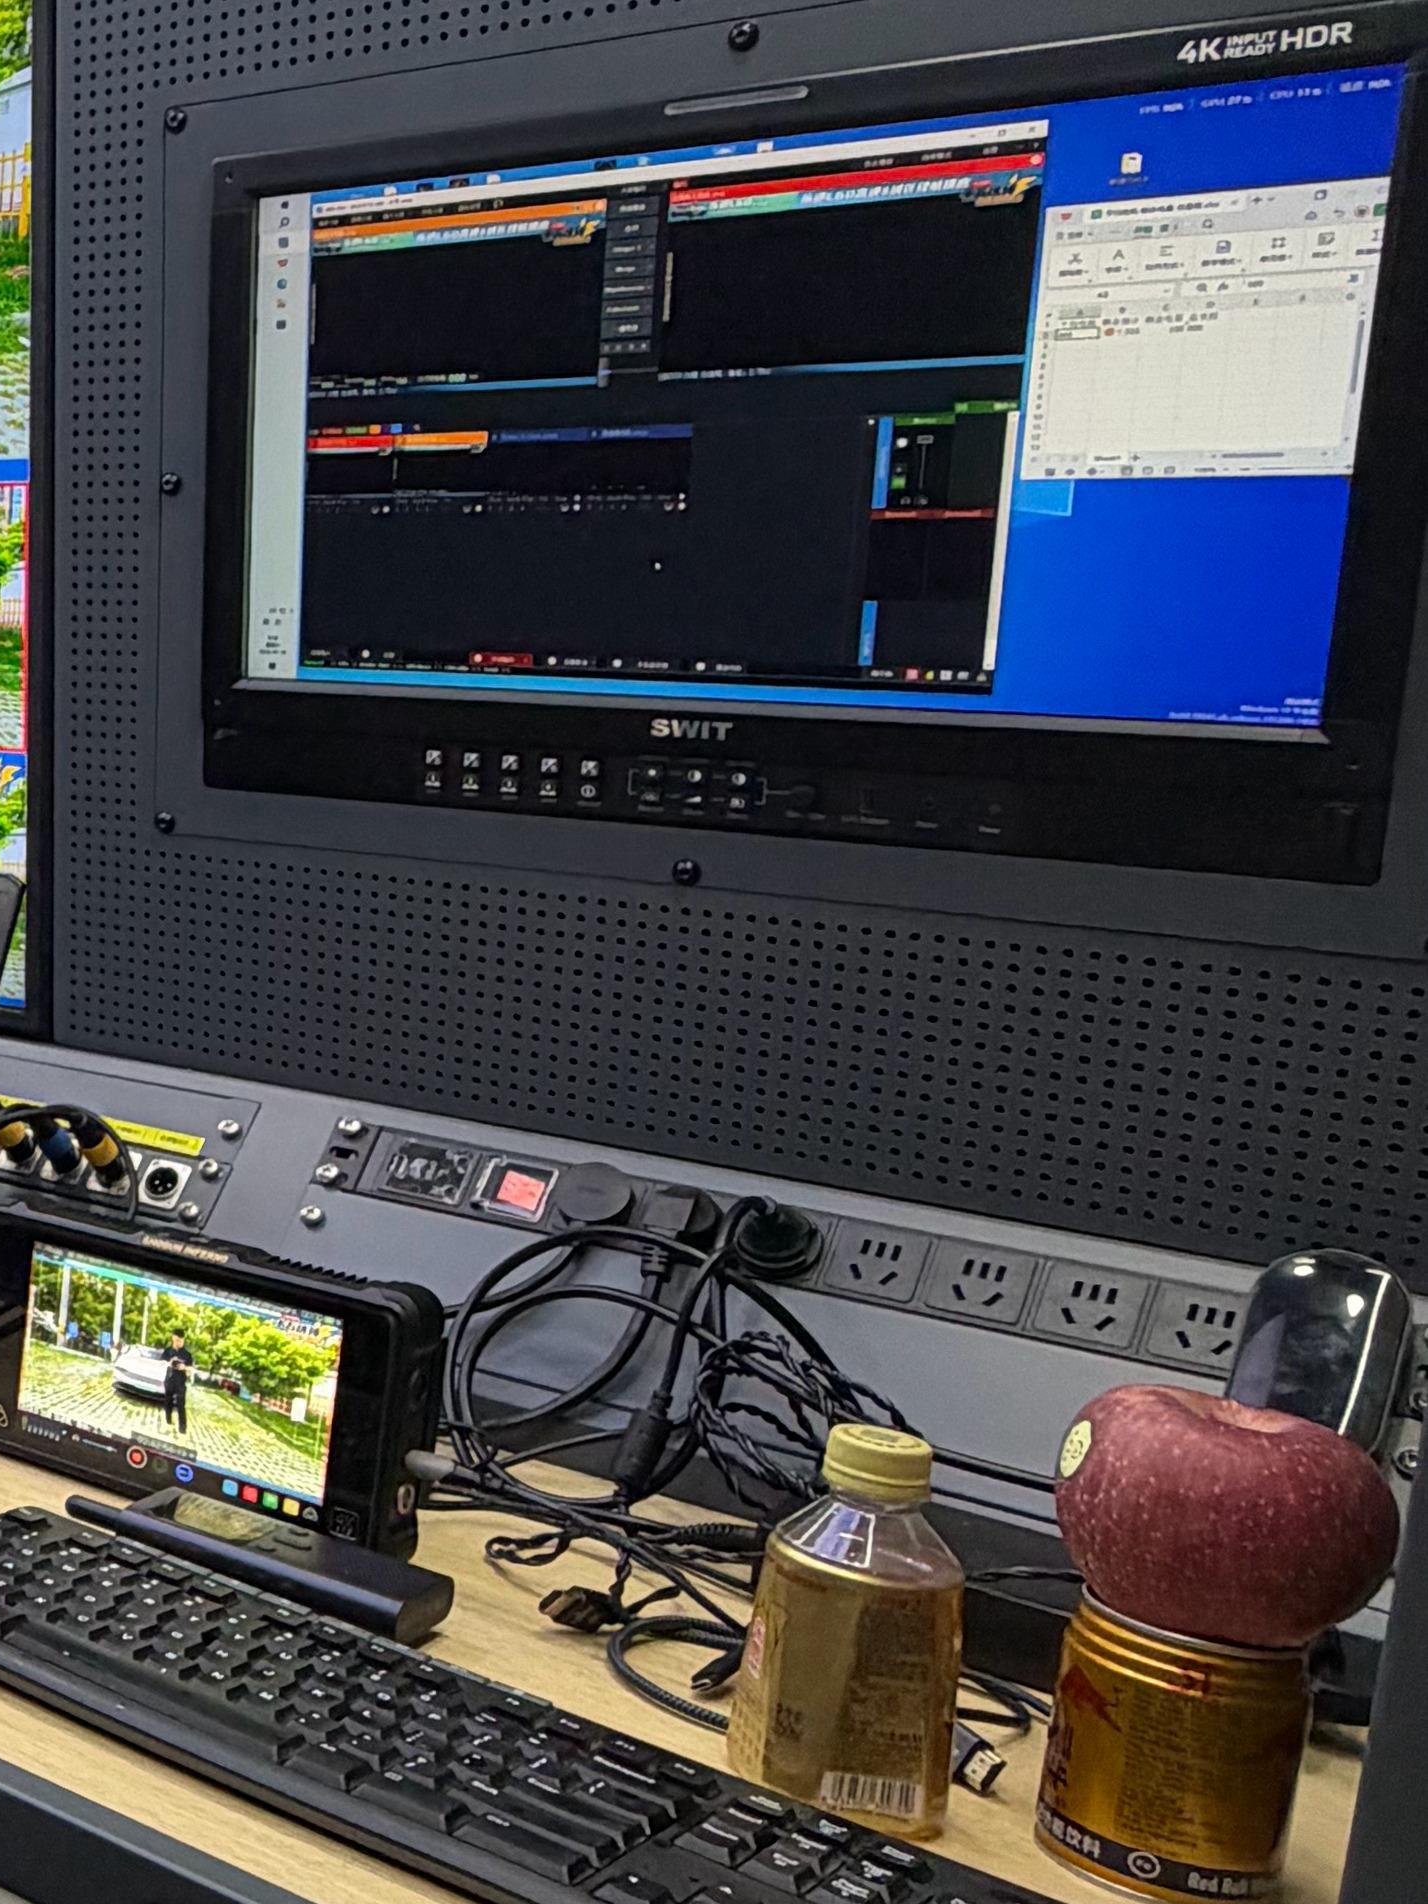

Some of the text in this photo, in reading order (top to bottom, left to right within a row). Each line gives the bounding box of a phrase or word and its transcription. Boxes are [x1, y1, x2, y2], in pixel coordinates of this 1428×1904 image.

[1177, 21, 1354, 64] 4K INPUT HDR
[1224, 42, 1276, 59] READY
[650, 718, 734, 742] SWIT
